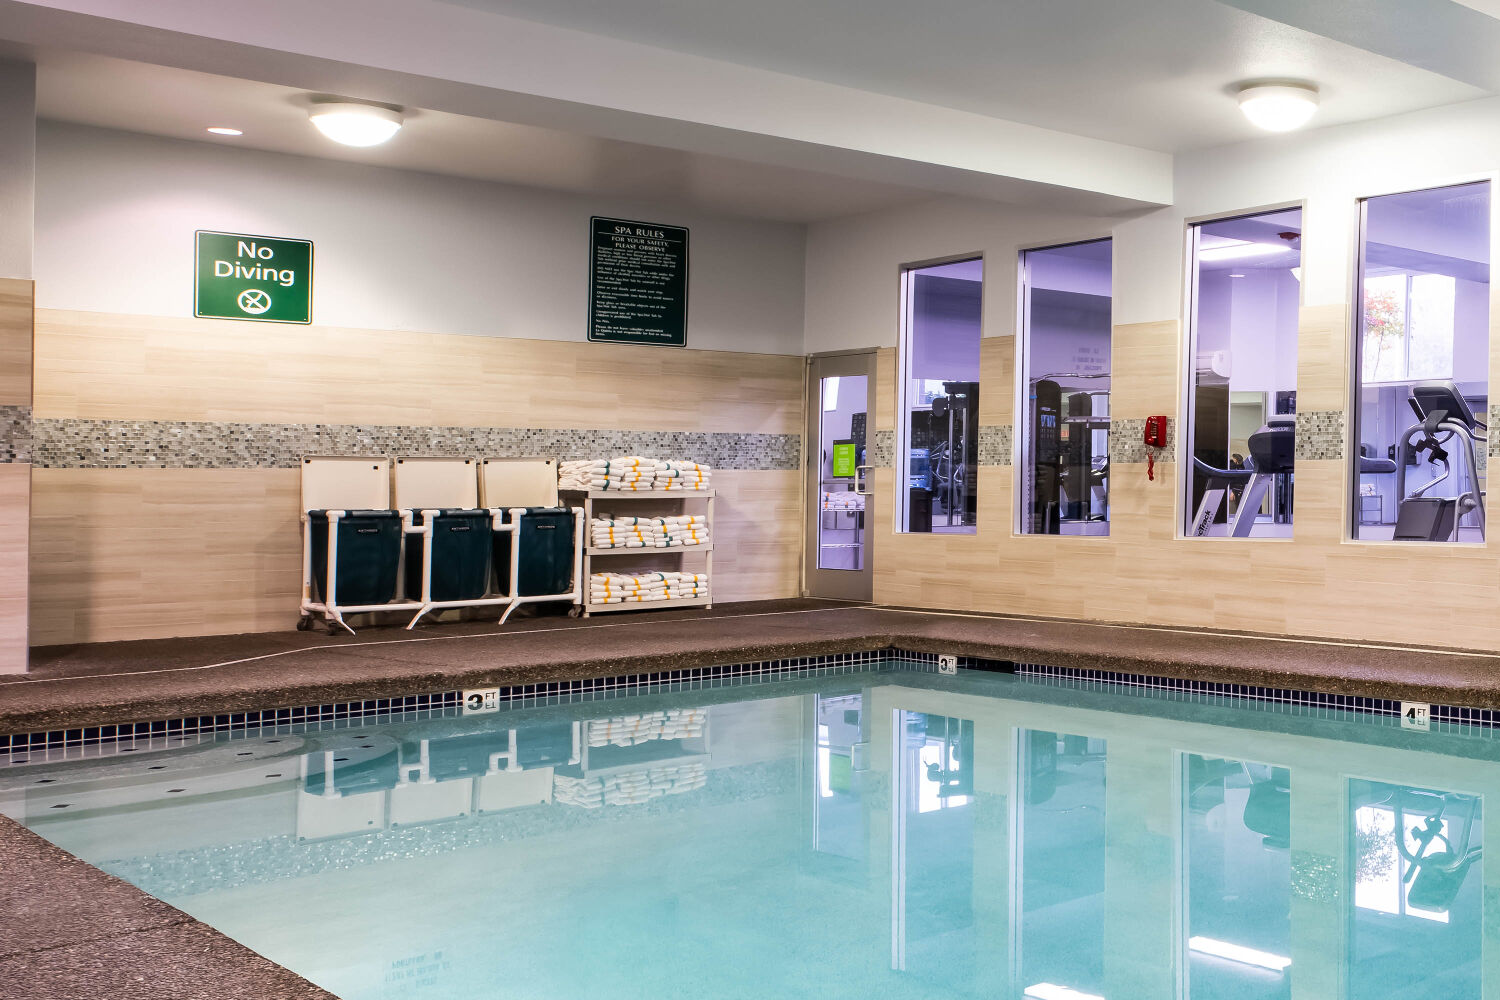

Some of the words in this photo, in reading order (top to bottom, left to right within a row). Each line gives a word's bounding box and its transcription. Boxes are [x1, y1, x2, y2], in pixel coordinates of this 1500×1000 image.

[614, 226, 632, 235] SPA
[636, 228, 664, 238] RULES
[237, 240, 274, 260] No
[214, 260, 295, 287] Diving
